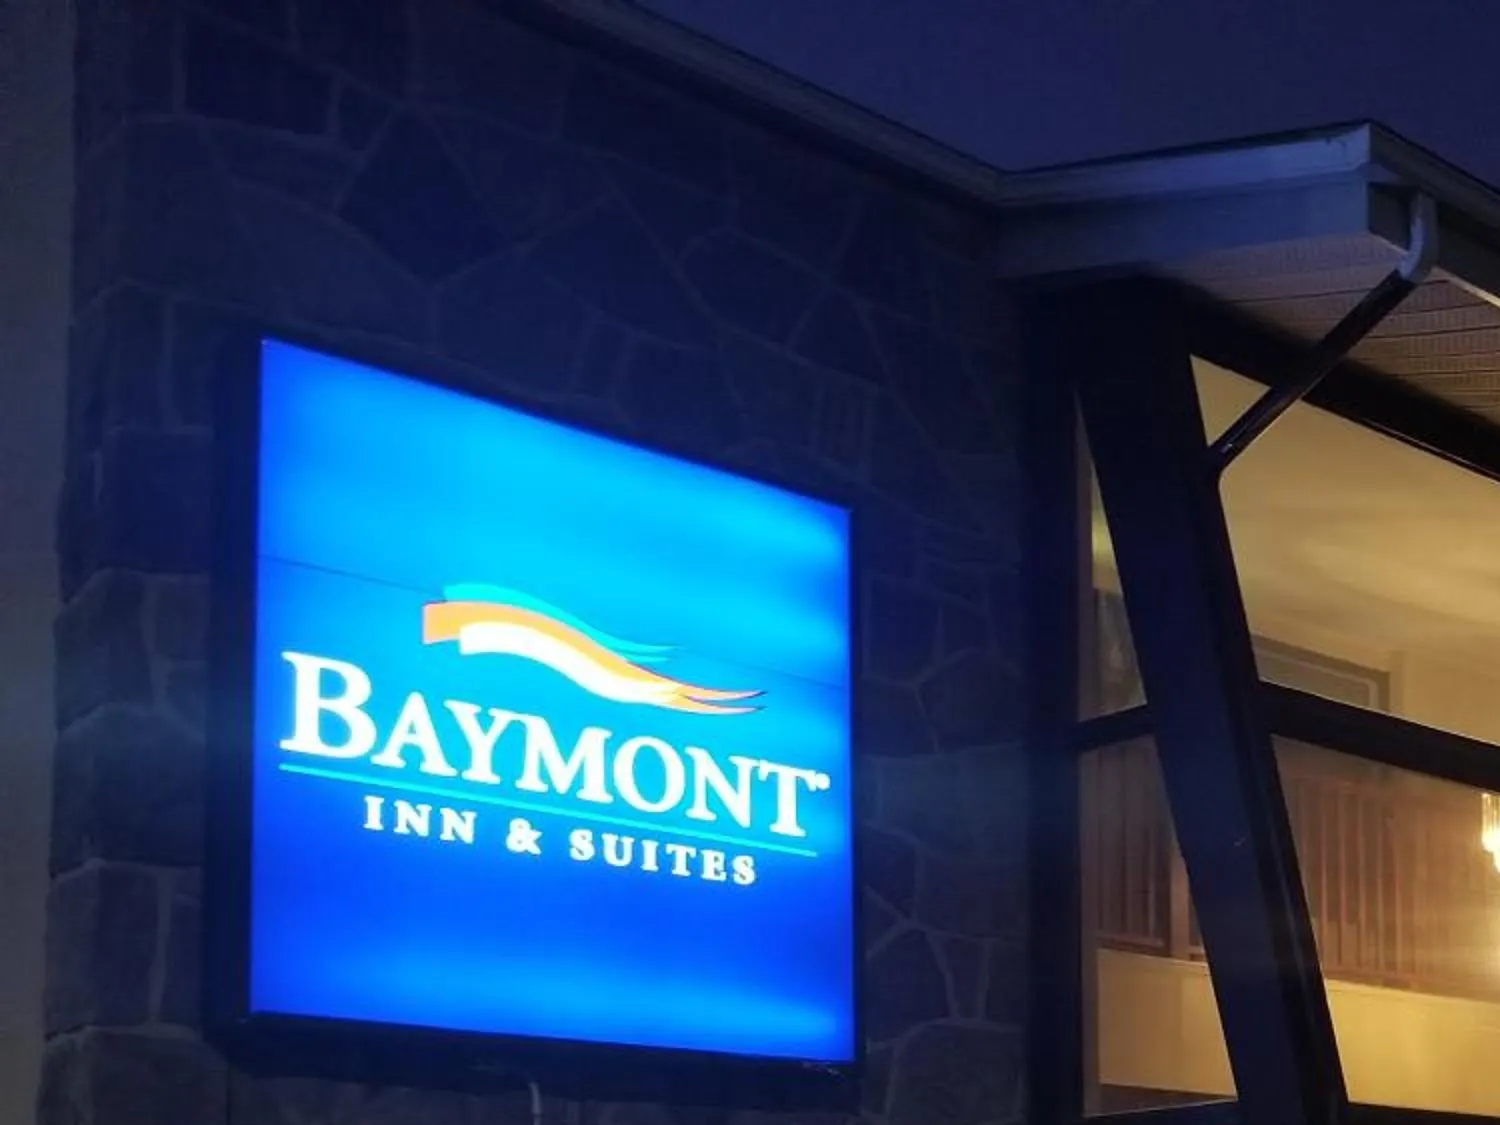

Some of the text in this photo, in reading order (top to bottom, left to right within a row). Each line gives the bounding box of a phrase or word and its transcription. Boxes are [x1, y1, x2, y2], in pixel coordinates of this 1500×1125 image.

[280, 650, 820, 838] BAYMONT
[363, 795, 758, 887] INN & SUITES
